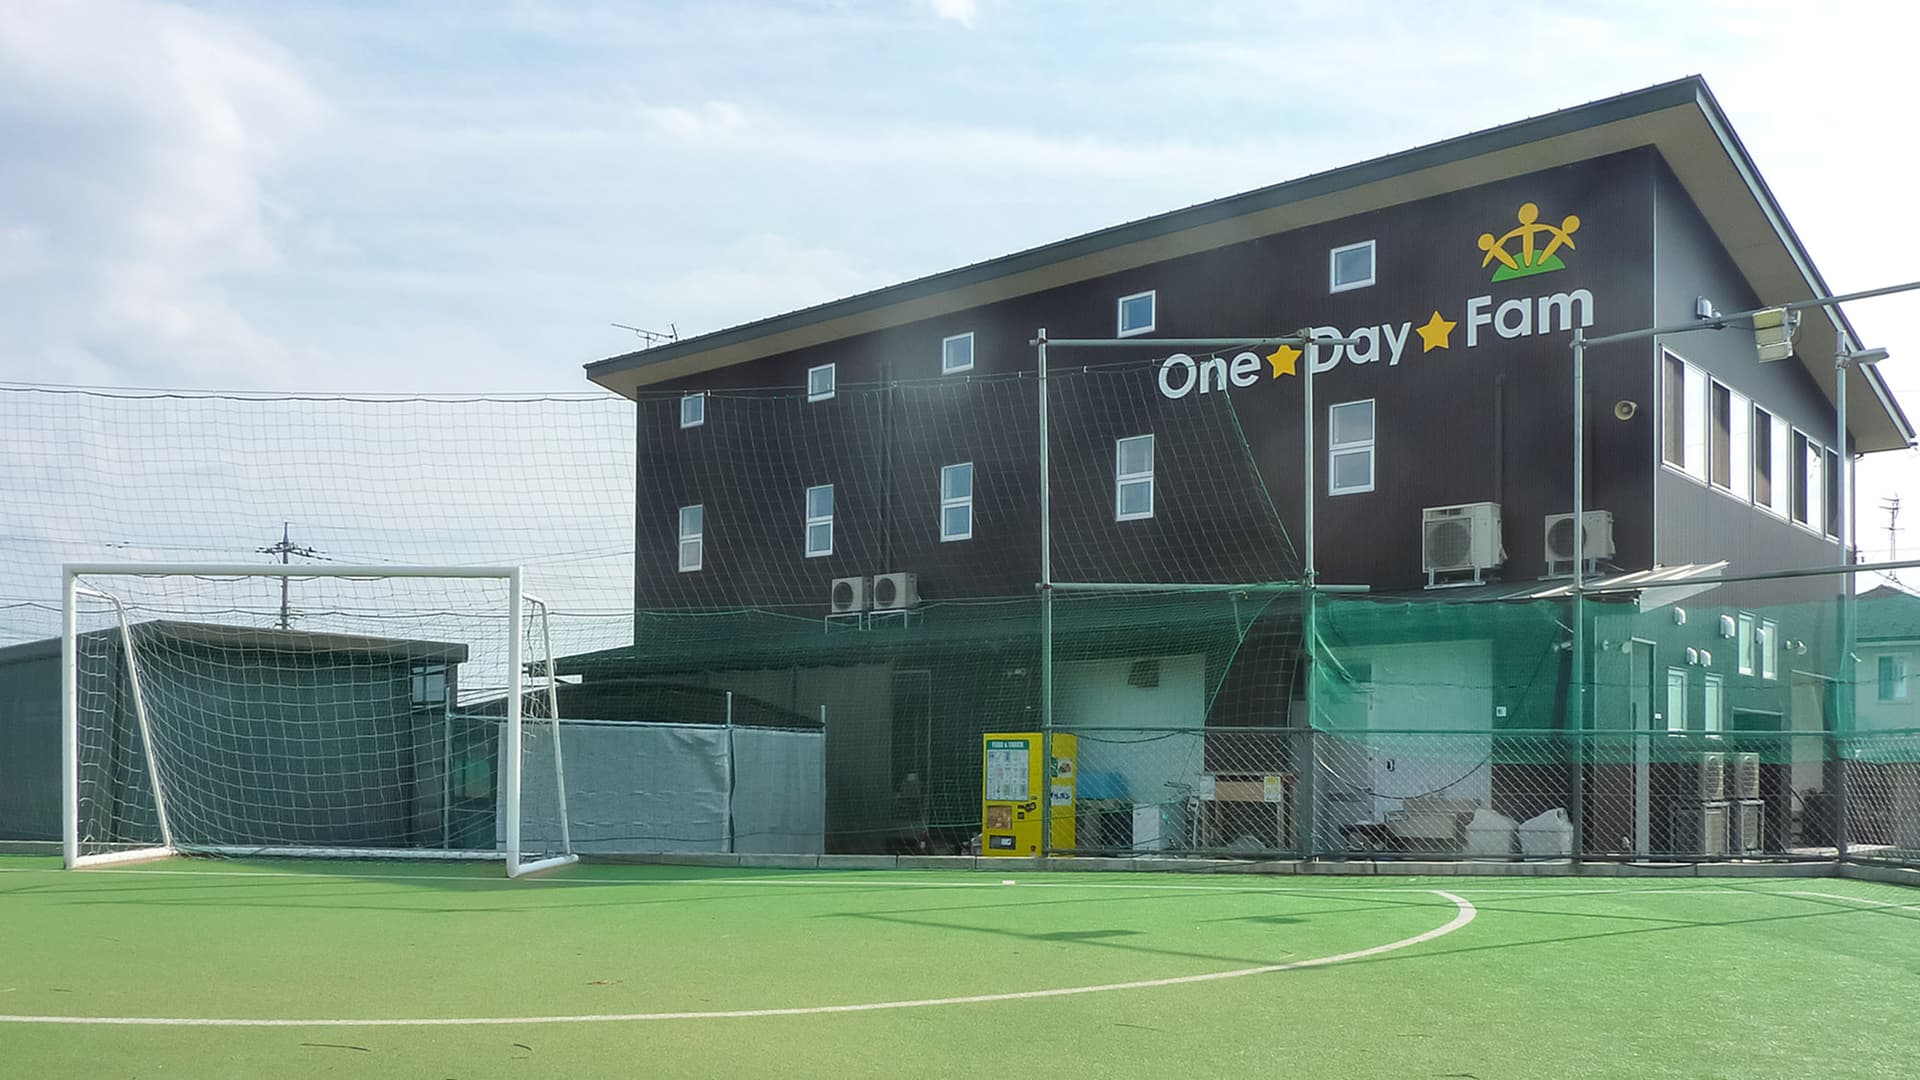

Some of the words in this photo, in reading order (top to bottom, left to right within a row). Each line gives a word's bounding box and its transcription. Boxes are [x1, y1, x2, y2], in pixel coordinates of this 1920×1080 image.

[1158, 351, 1261, 399] One
[1311, 322, 1411, 374] Day
[1467, 288, 1594, 347] Fam
